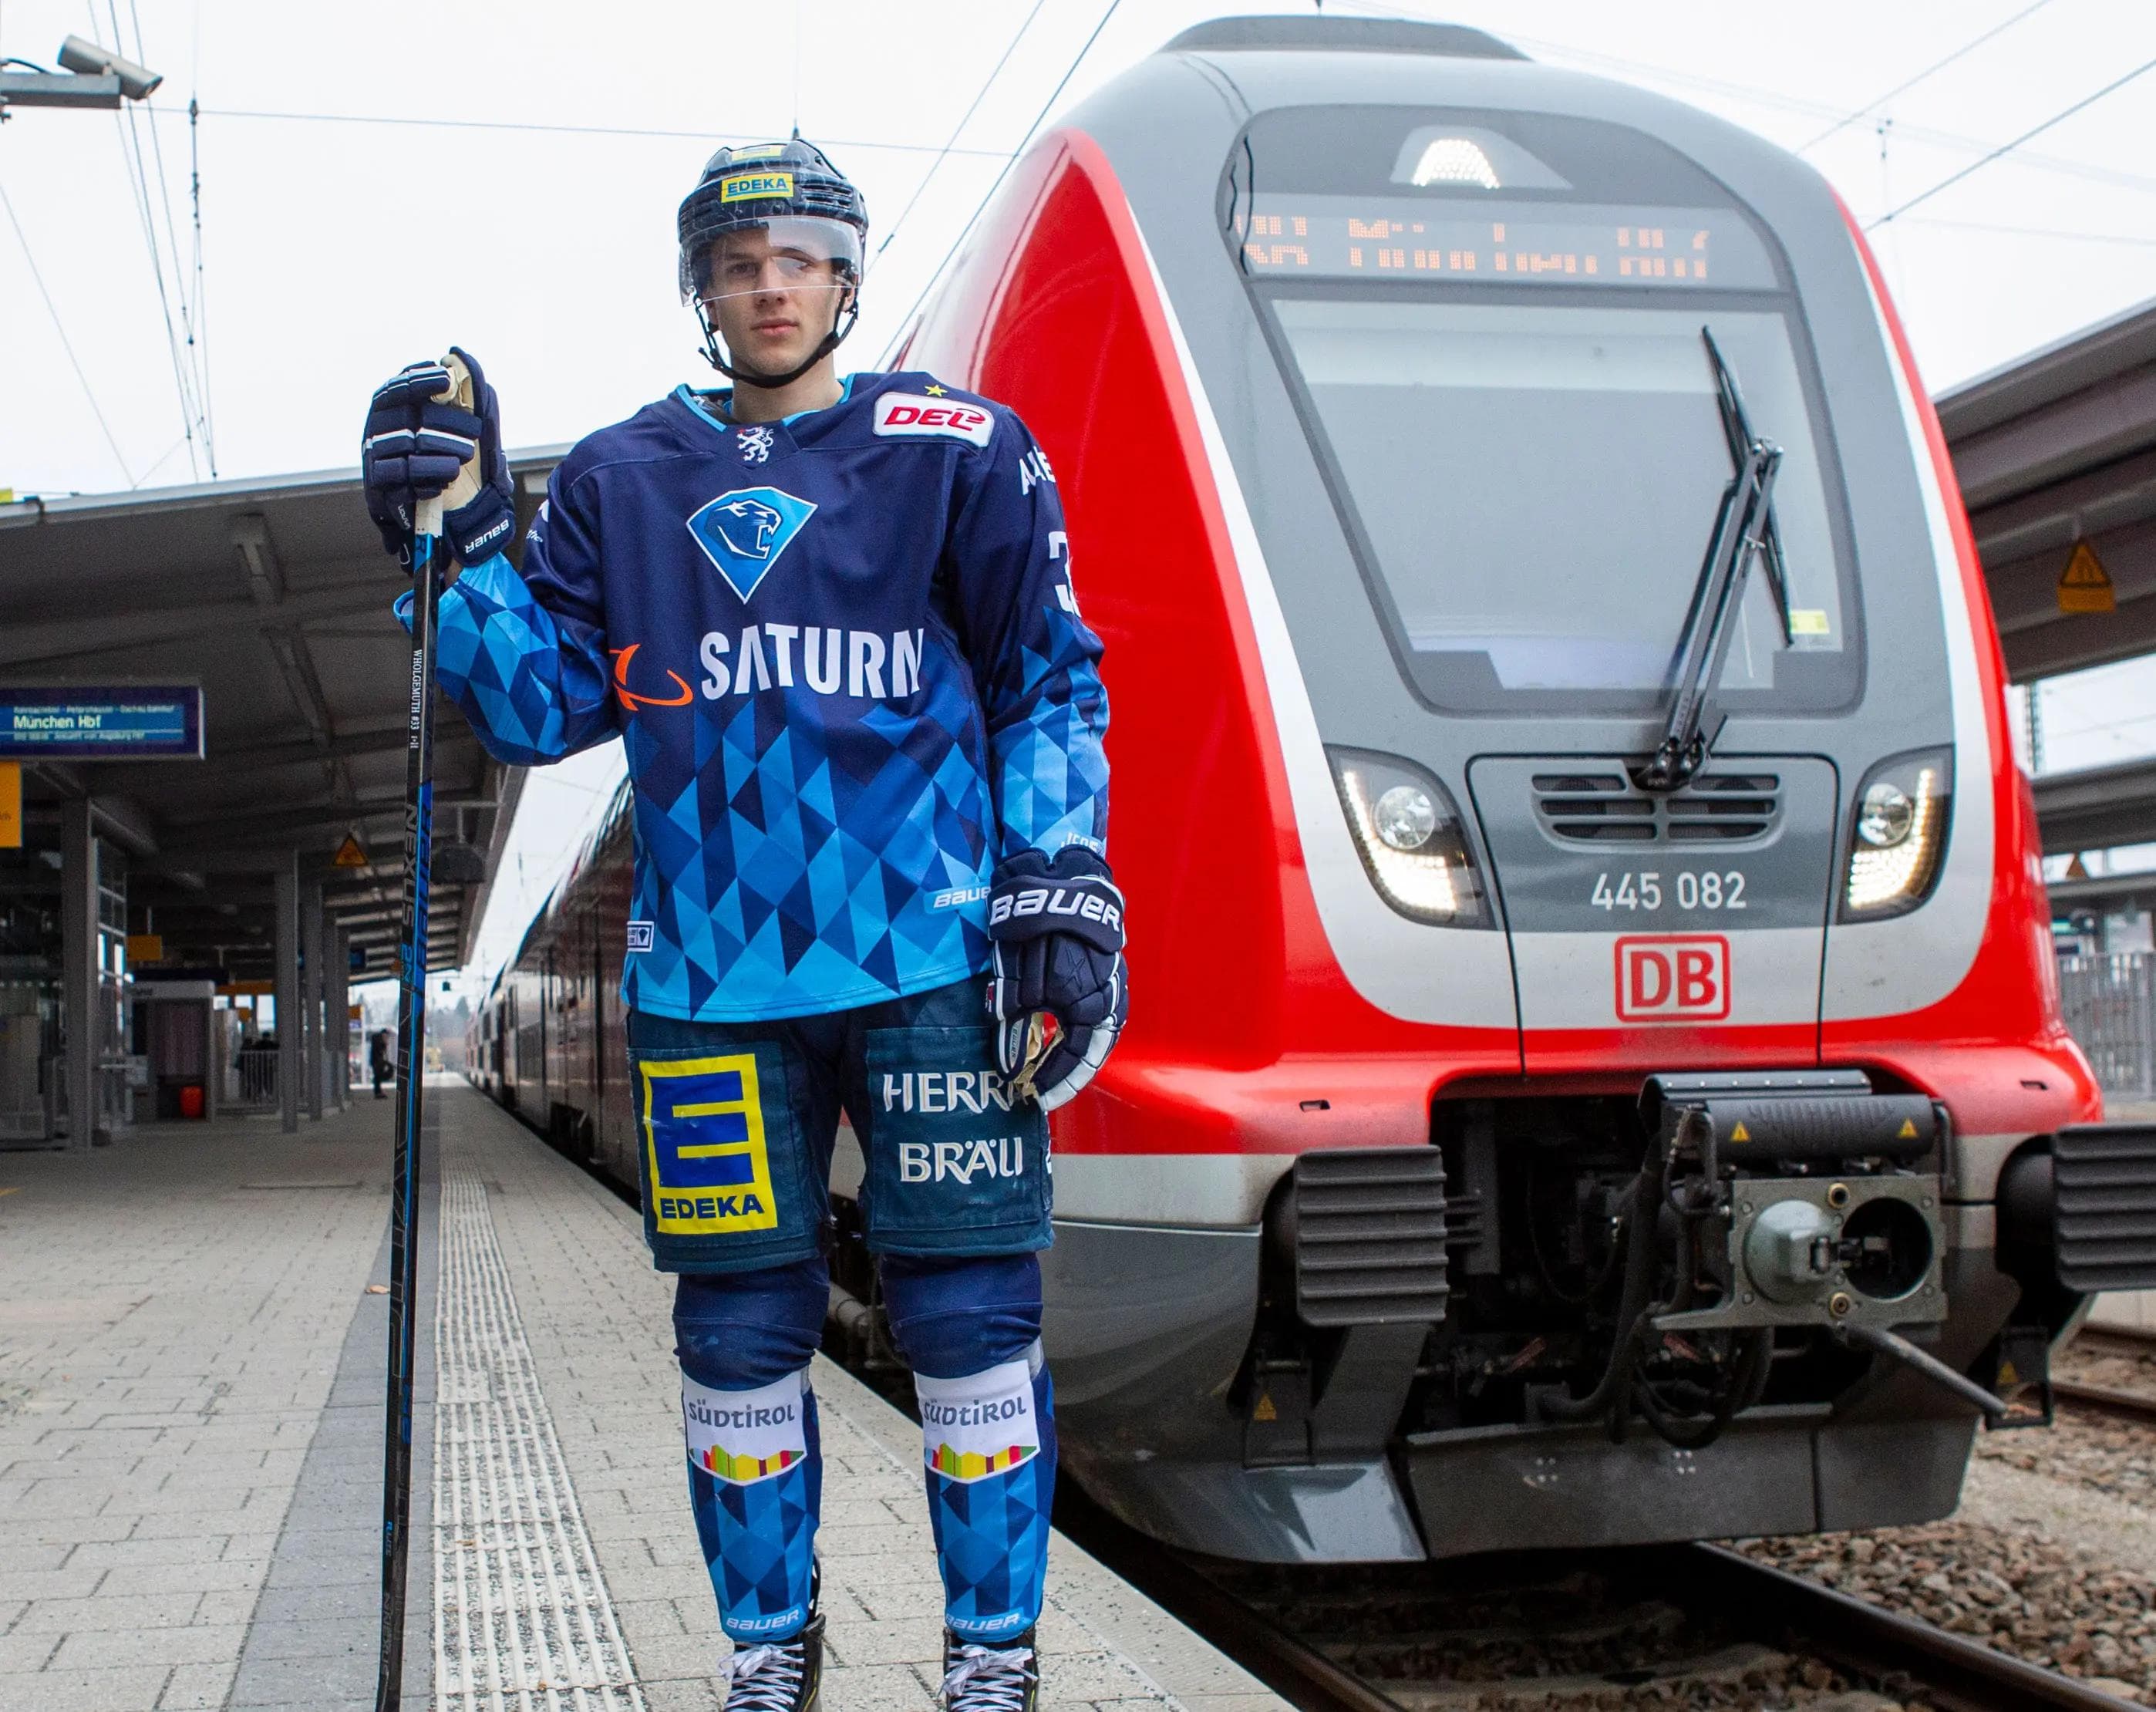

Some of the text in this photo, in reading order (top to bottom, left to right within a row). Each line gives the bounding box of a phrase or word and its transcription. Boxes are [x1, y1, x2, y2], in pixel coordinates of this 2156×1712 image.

[727, 177, 788, 194] EDEKA
[410, 649, 423, 713] WHOLGEMUTH
[699, 622, 924, 700] SATURN
[13, 714, 102, 730] München Hbf
[401, 803, 418, 928] NEXUS
[933, 886, 991, 908] BAUE
[1591, 871, 1747, 910] 445 082
[1629, 950, 1717, 1009] DB
[883, 1070, 1019, 1115] HERR
[899, 1136, 1023, 1185] BRÄU
[659, 1194, 766, 1220] EDEKA
